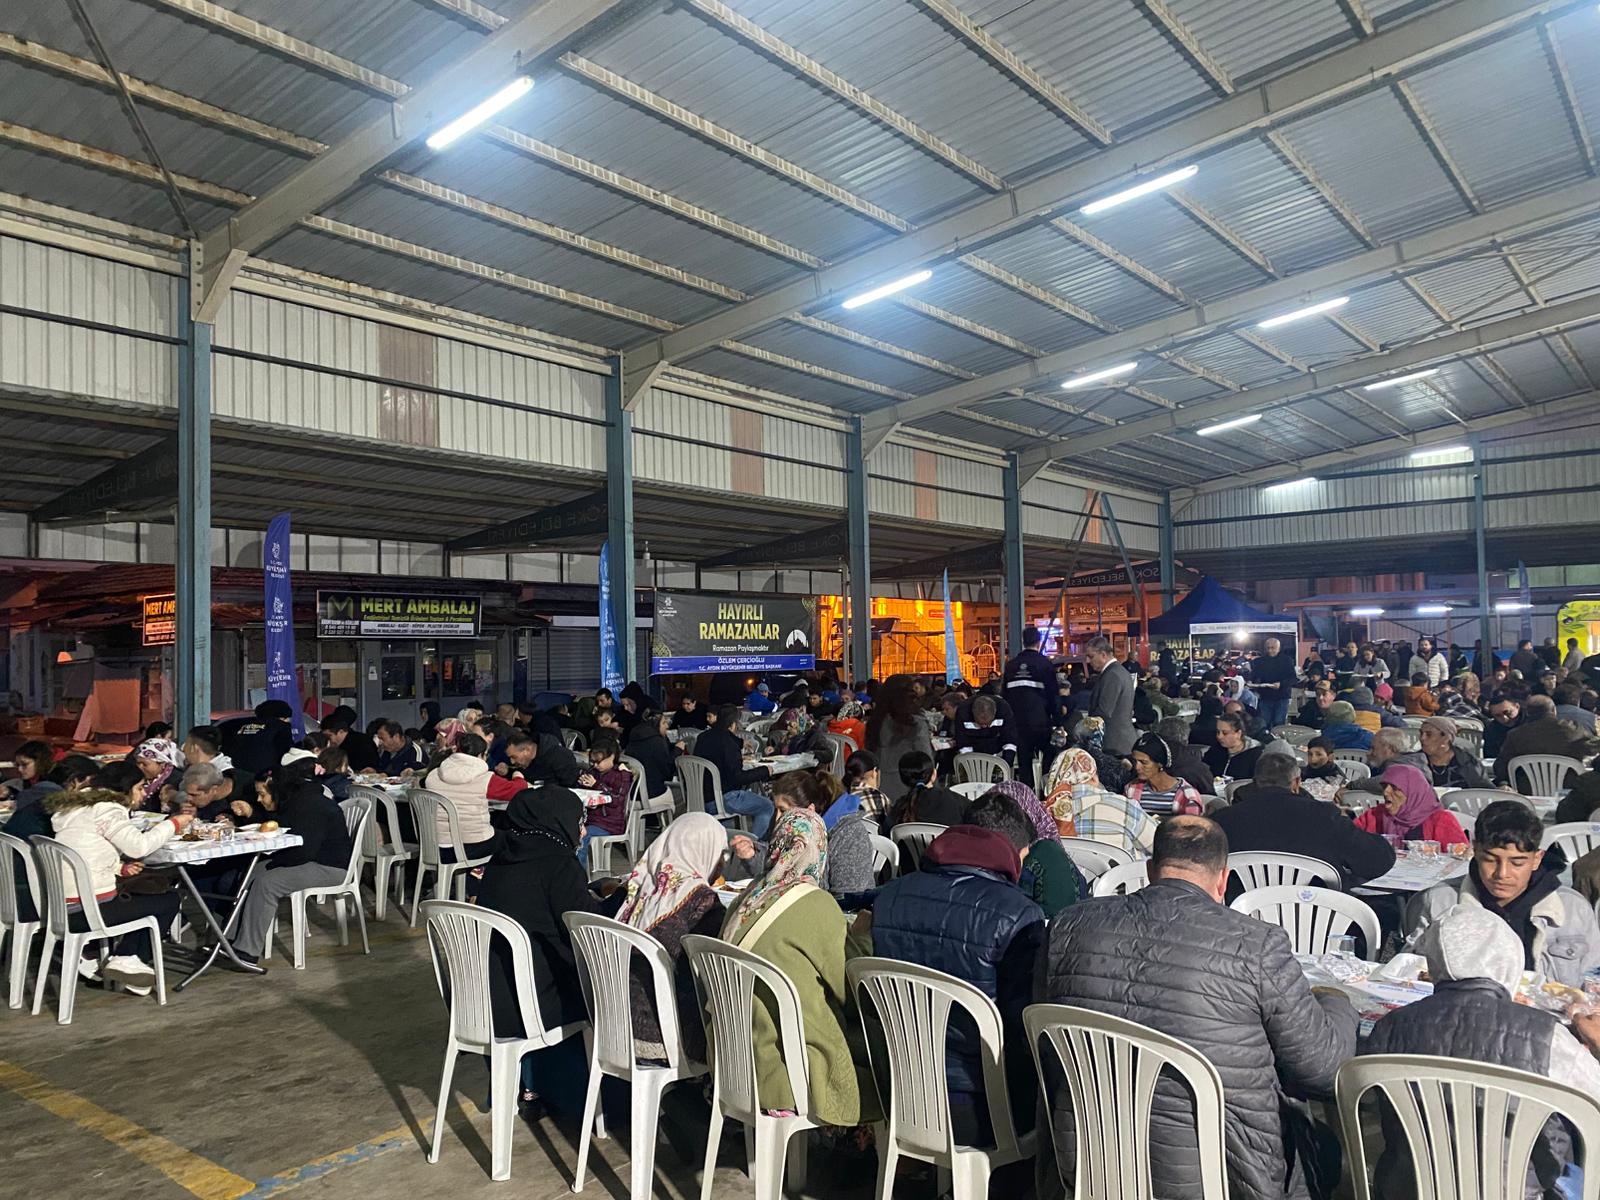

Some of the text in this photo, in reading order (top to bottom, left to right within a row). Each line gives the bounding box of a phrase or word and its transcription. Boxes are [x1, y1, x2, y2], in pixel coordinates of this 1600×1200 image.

[145, 602, 162, 615] MERT
[361, 597, 476, 615] MERT AMBALAJ
[718, 602, 763, 621] HAYIRLI
[699, 622, 780, 640] RAMAZANLAR
[712, 644, 737, 652] Ramazan
[718, 656, 736, 664] ÖZLEM
